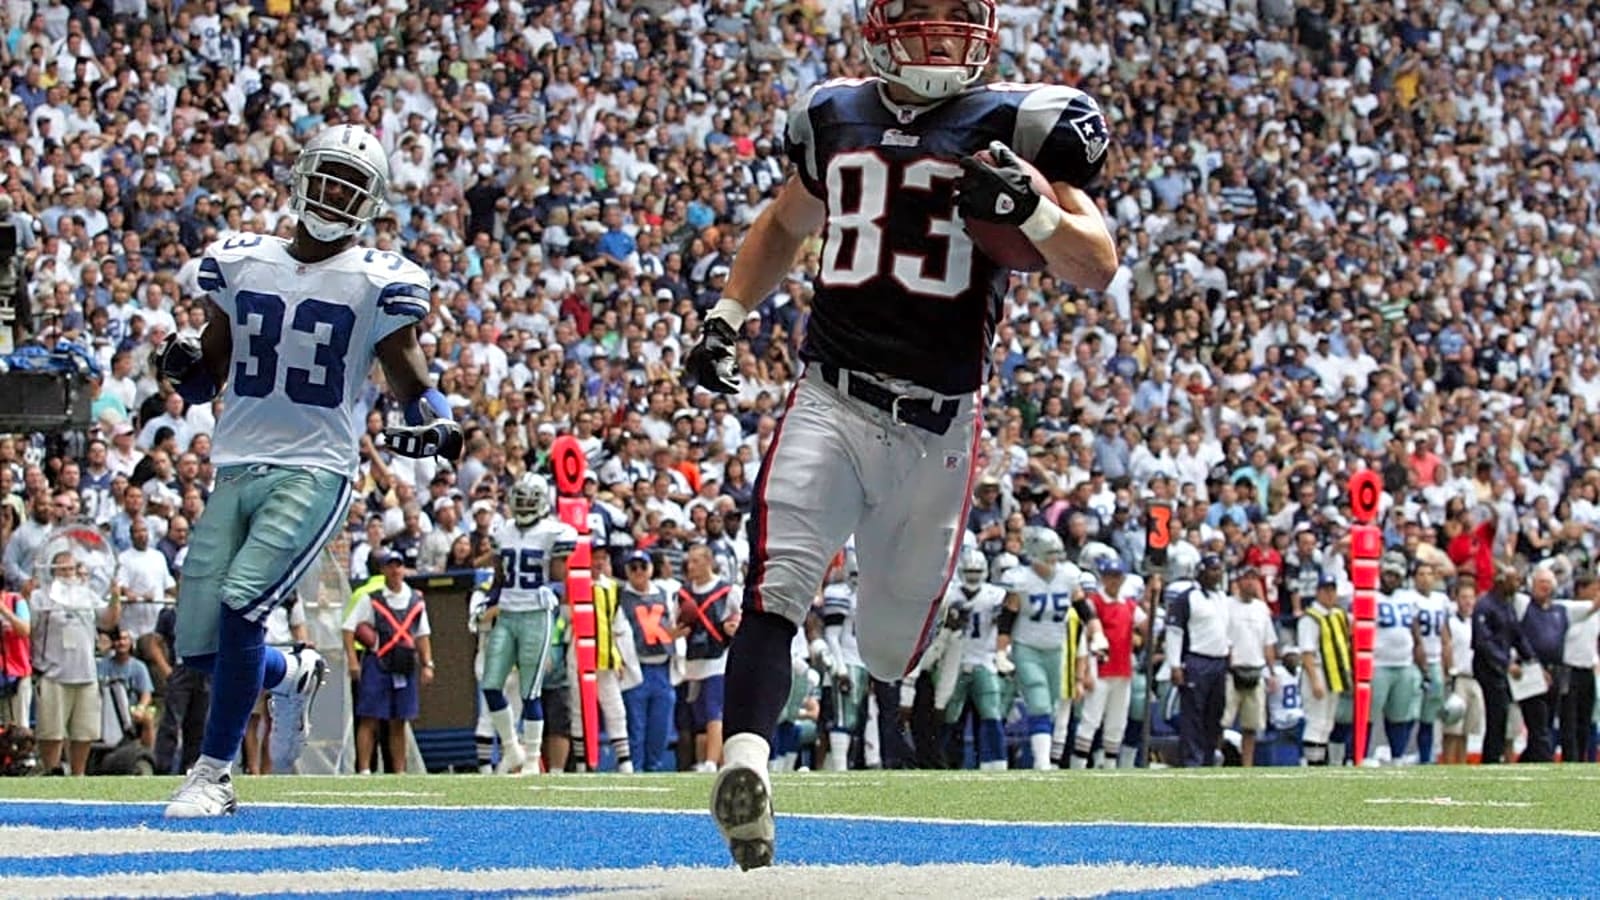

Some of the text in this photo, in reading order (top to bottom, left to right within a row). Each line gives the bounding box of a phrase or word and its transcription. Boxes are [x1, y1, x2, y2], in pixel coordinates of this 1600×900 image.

[820, 150, 975, 299] 83
[234, 289, 357, 409] 33
[1149, 505, 1171, 549] 3
[634, 602, 673, 646] K
[1029, 592, 1069, 623] 75
[1283, 684, 1303, 710] 8
